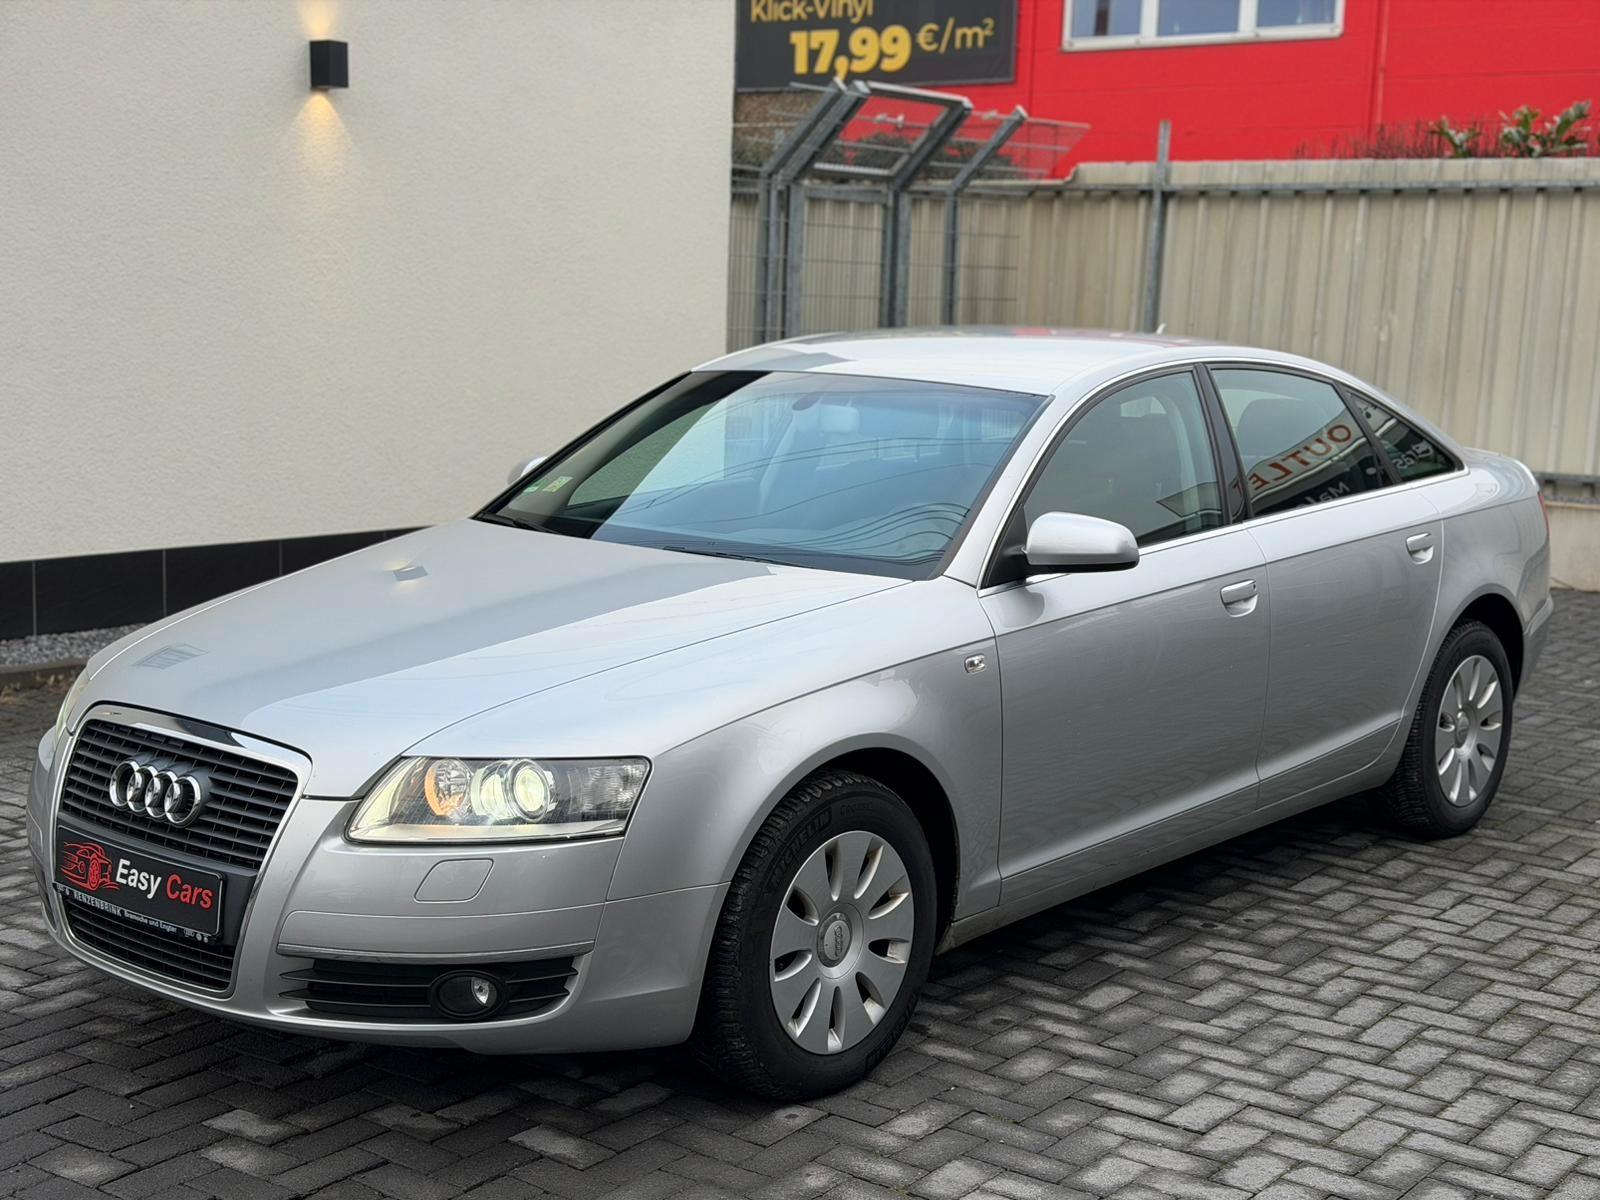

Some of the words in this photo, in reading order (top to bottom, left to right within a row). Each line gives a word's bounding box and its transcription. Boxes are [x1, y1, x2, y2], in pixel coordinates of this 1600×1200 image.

[751, 0, 874, 24] Klick-Vinyl
[789, 25, 912, 80] 17,99
[116, 858, 161, 899] Easy
[167, 874, 214, 909] Cars
